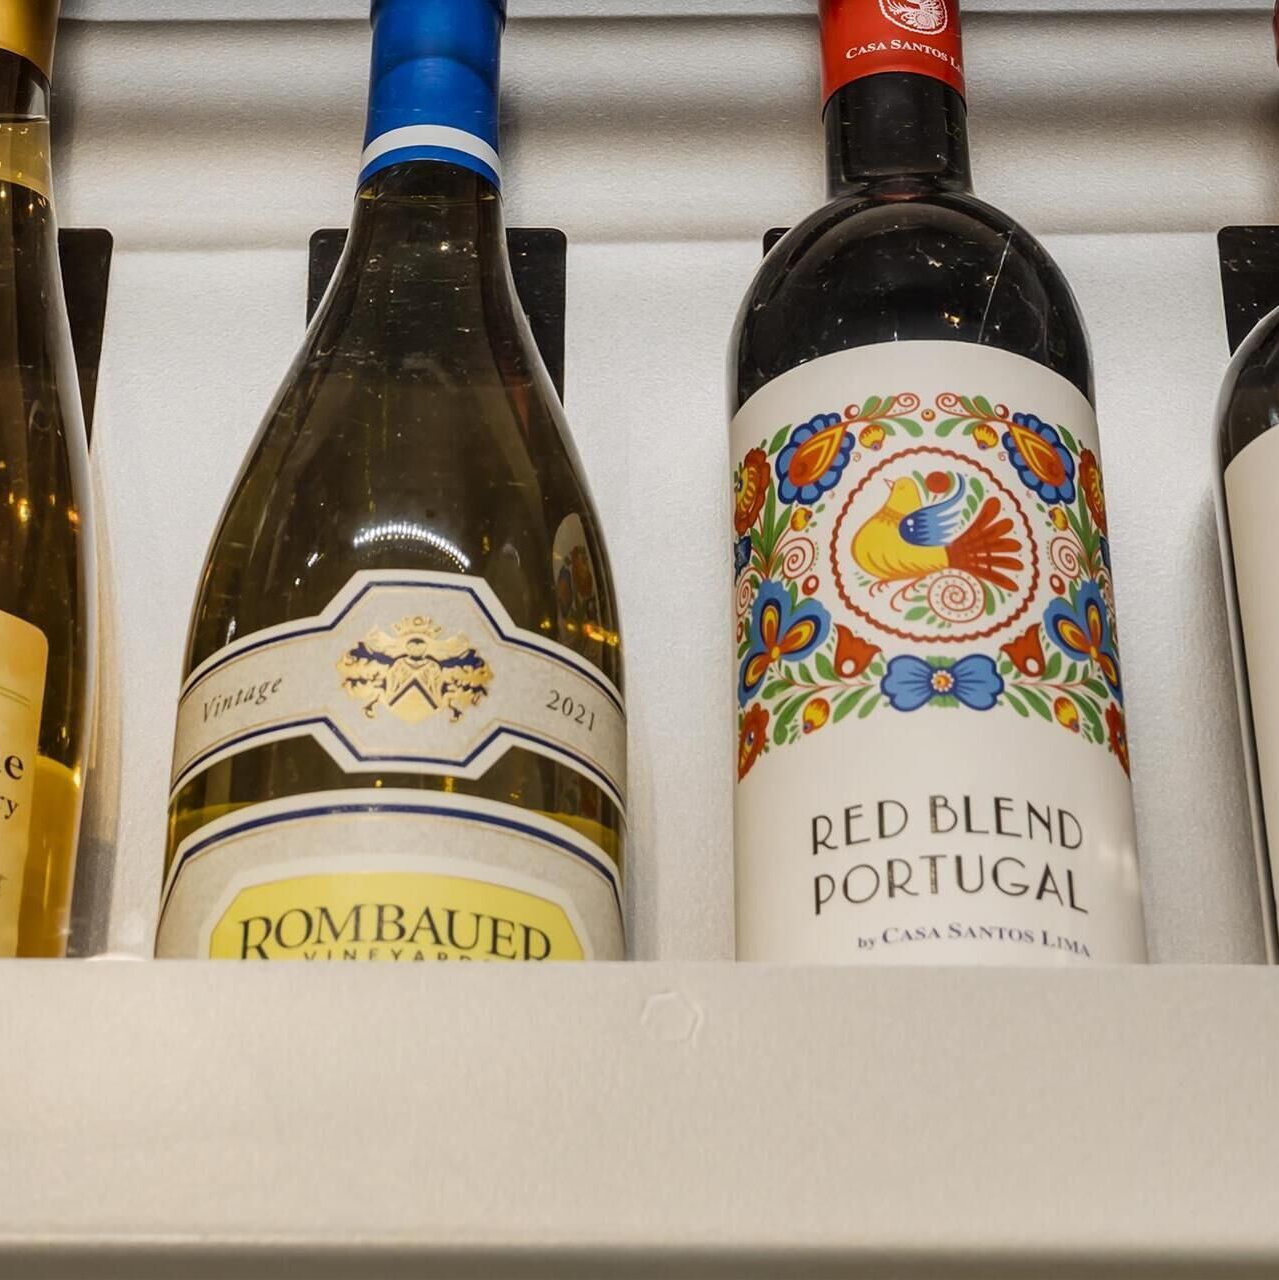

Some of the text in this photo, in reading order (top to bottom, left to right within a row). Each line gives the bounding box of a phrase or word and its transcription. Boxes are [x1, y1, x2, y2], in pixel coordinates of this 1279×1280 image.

[845, 39, 948, 62] CASA SANTOS
[202, 673, 284, 723] Vintage
[545, 689, 597, 732] 2021
[811, 794, 1083, 855] RED BLEND
[814, 853, 1089, 915] PORTUGAL
[857, 922, 1091, 959] by CASA SANTOS LIMA
